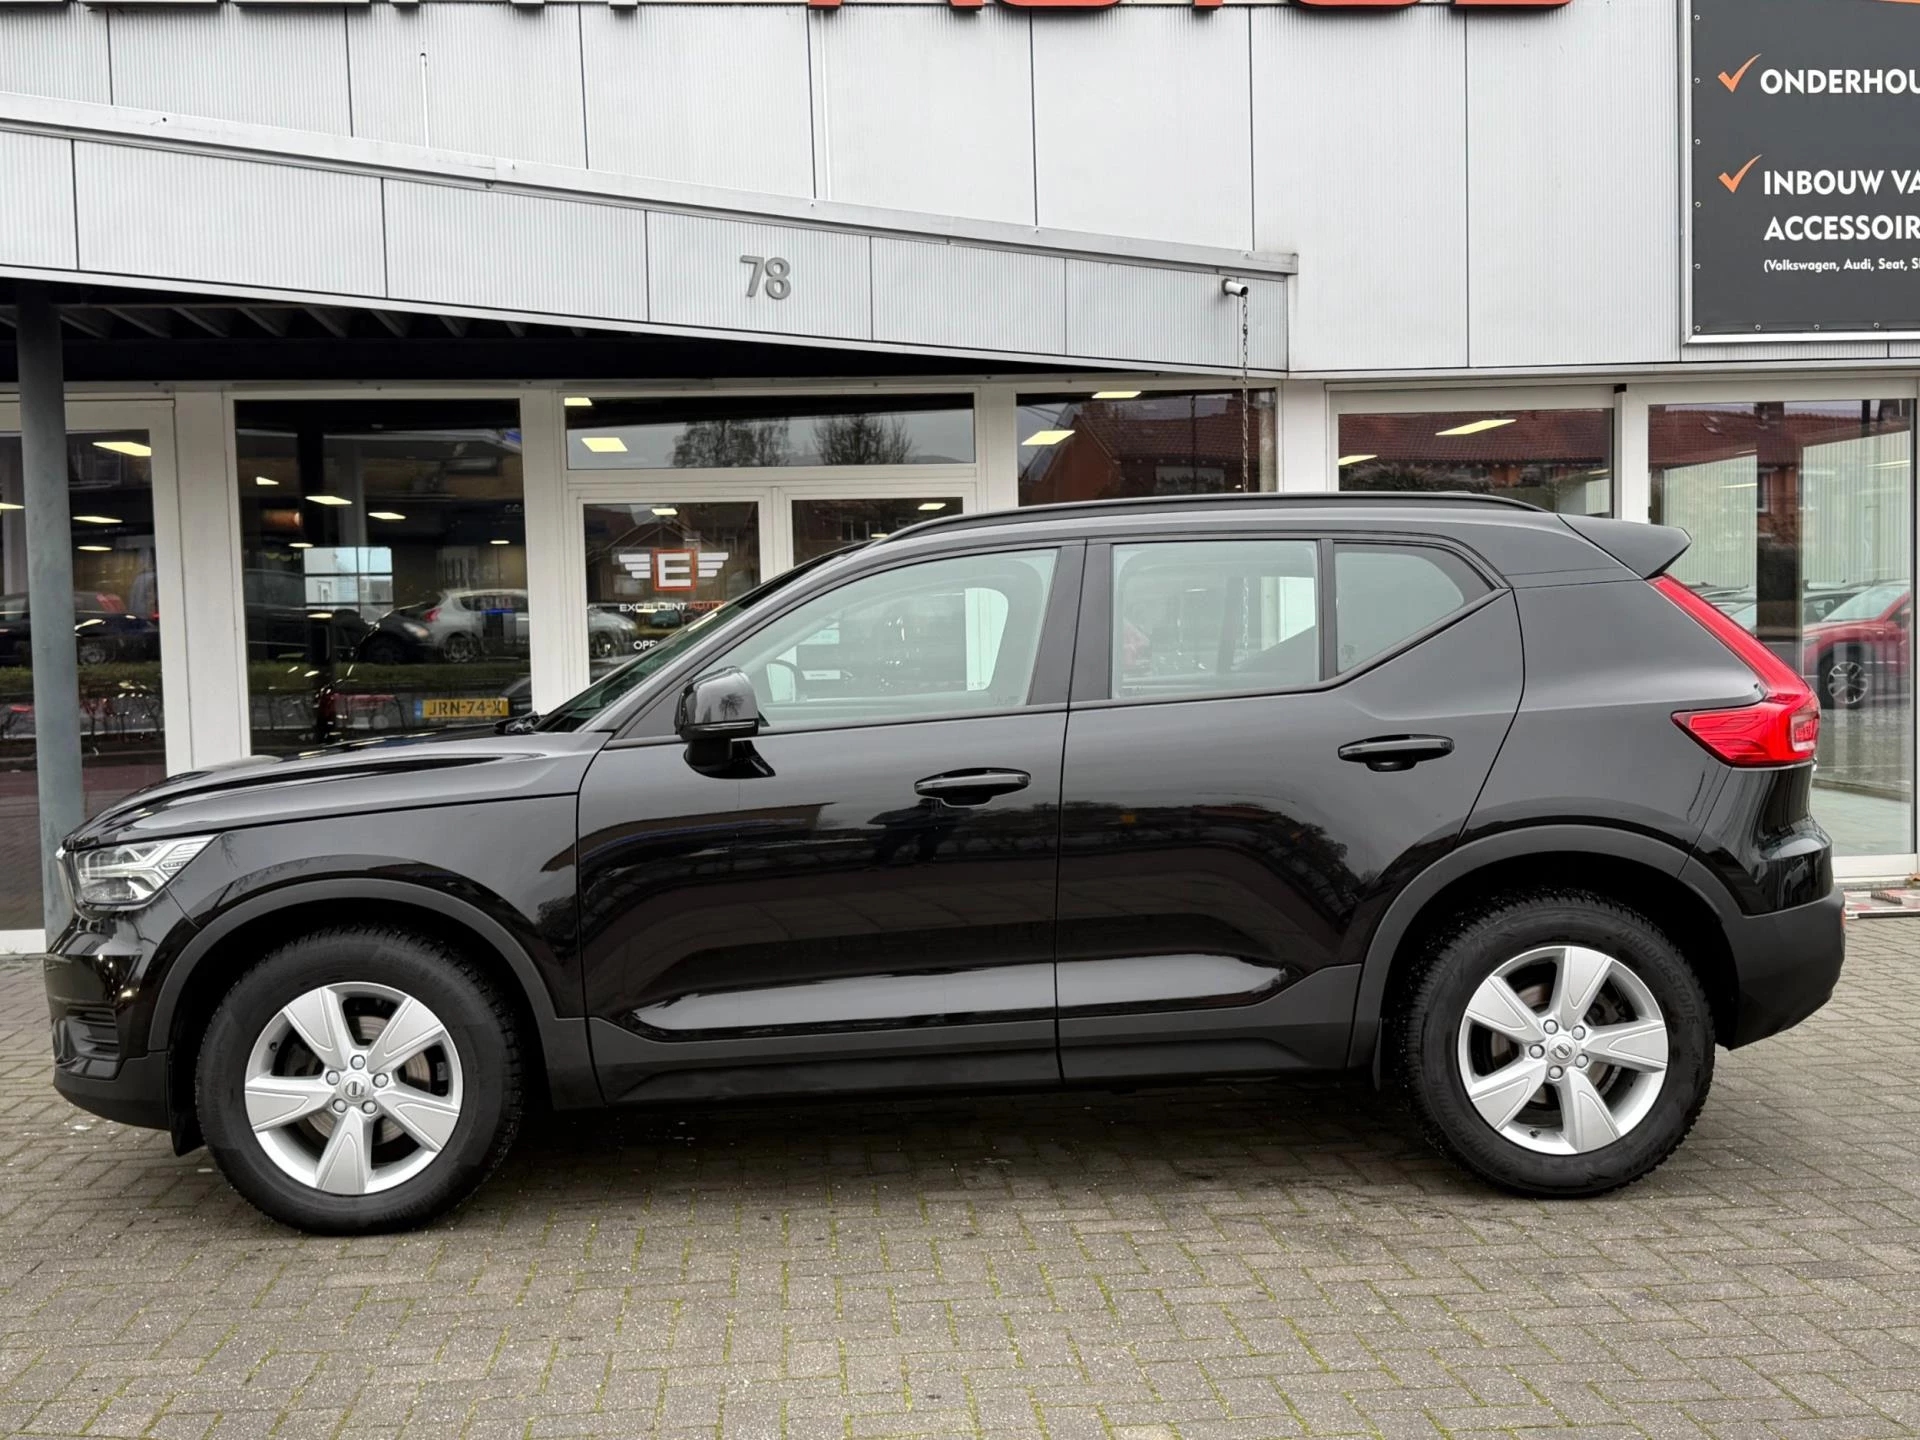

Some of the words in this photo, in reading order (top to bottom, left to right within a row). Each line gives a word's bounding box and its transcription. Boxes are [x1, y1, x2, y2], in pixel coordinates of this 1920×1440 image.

[1764, 169, 1884, 195] INBOUW
[1763, 214, 1920, 241] ACCESSOIR
[740, 255, 791, 300] 78
[1763, 259, 1840, 273] (Volkswagen,
[1843, 259, 1874, 272] Audi,
[1878, 257, 1908, 271] Seat,
[1911, 257, 1920, 269] S
[657, 552, 692, 587] E
[429, 700, 502, 716] JRN-74-X
